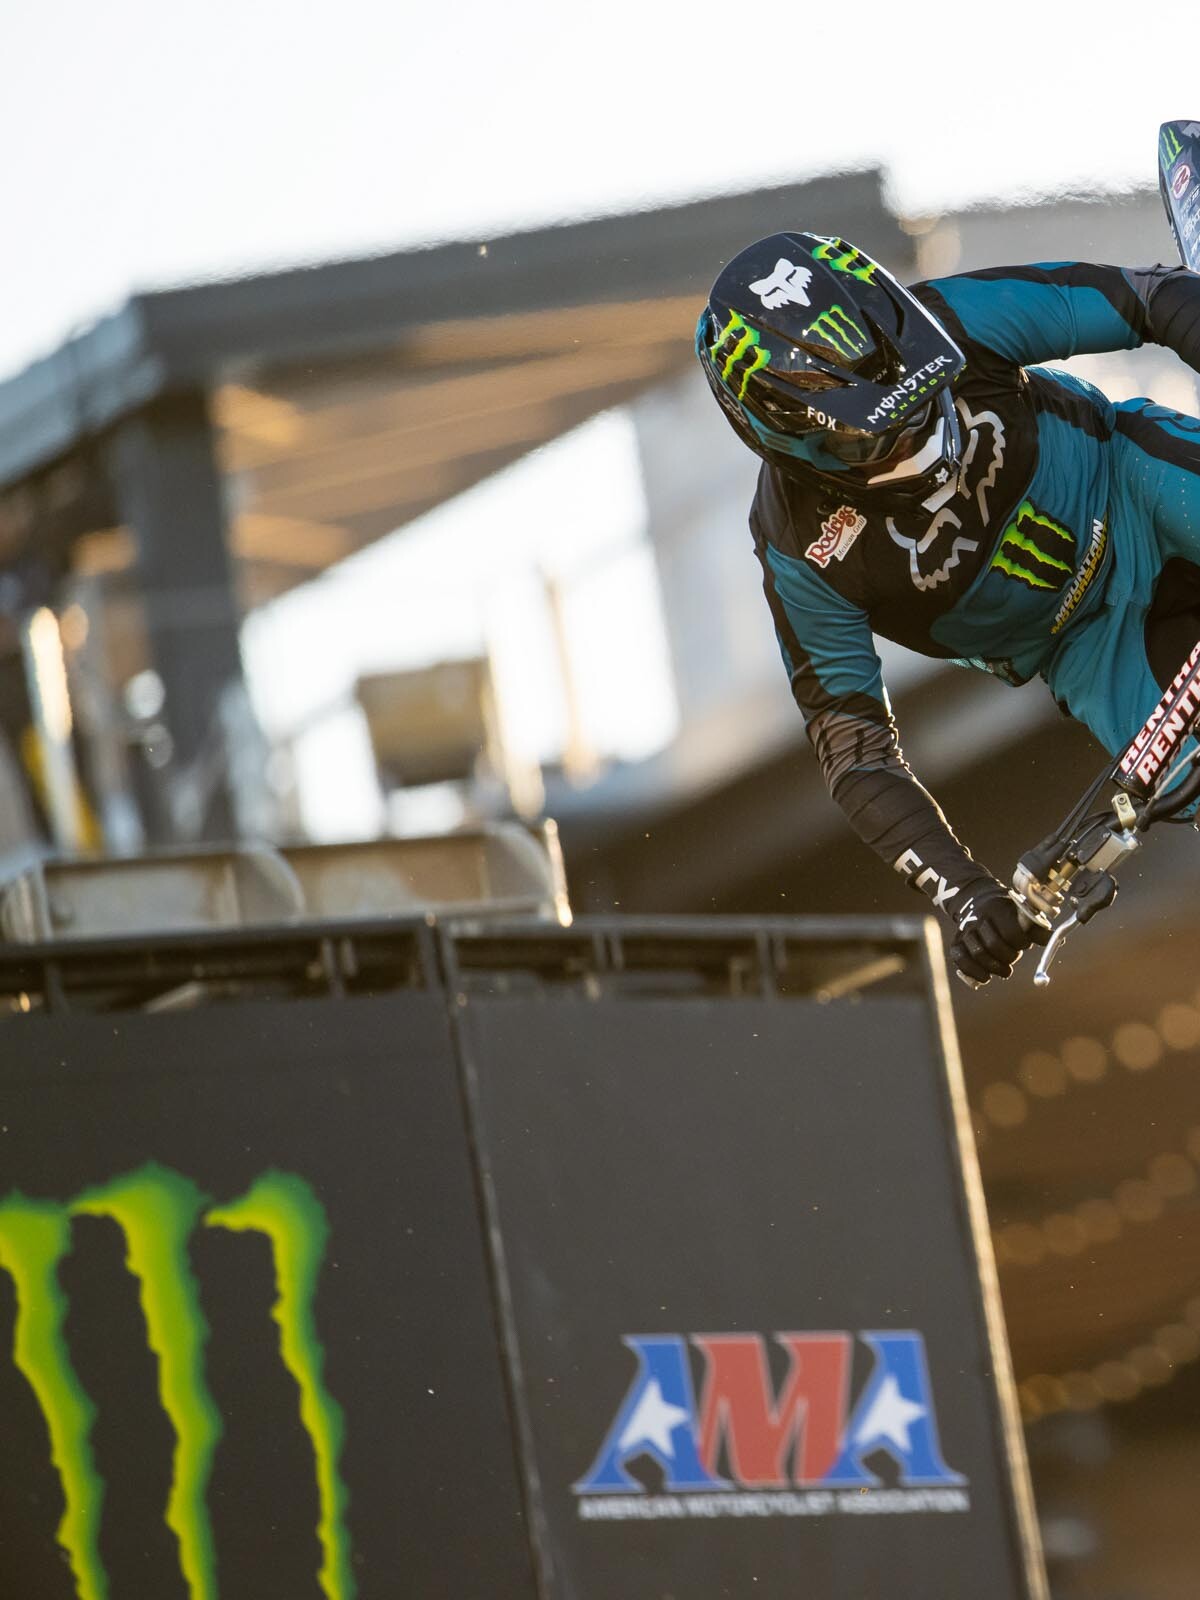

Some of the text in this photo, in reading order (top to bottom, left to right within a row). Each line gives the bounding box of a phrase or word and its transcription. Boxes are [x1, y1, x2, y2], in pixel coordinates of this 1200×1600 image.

[807, 406, 837, 431] FOX
[867, 355, 953, 425] MONSTER
[889, 371, 947, 420] ENERGY
[851, 516, 866, 535] Grill
[1054, 519, 1104, 623] MOUNTAIN
[570, 1329, 970, 1495] AMA
